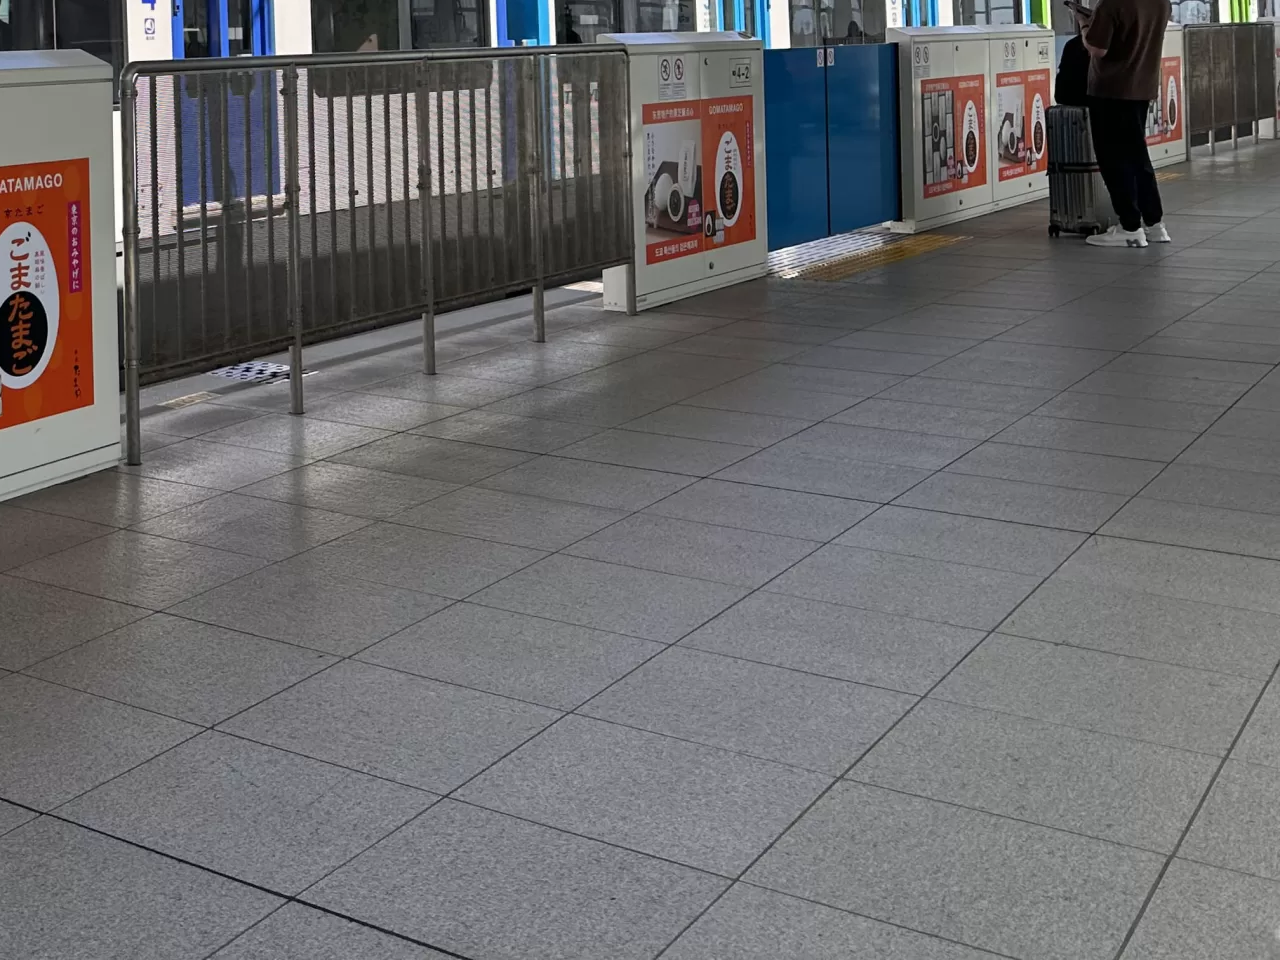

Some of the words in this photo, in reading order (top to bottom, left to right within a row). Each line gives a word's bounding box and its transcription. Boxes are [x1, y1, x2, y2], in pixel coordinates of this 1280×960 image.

[8, 231, 38, 375] ごまたまご
[71, 203, 80, 290] 東京のおみやげに
